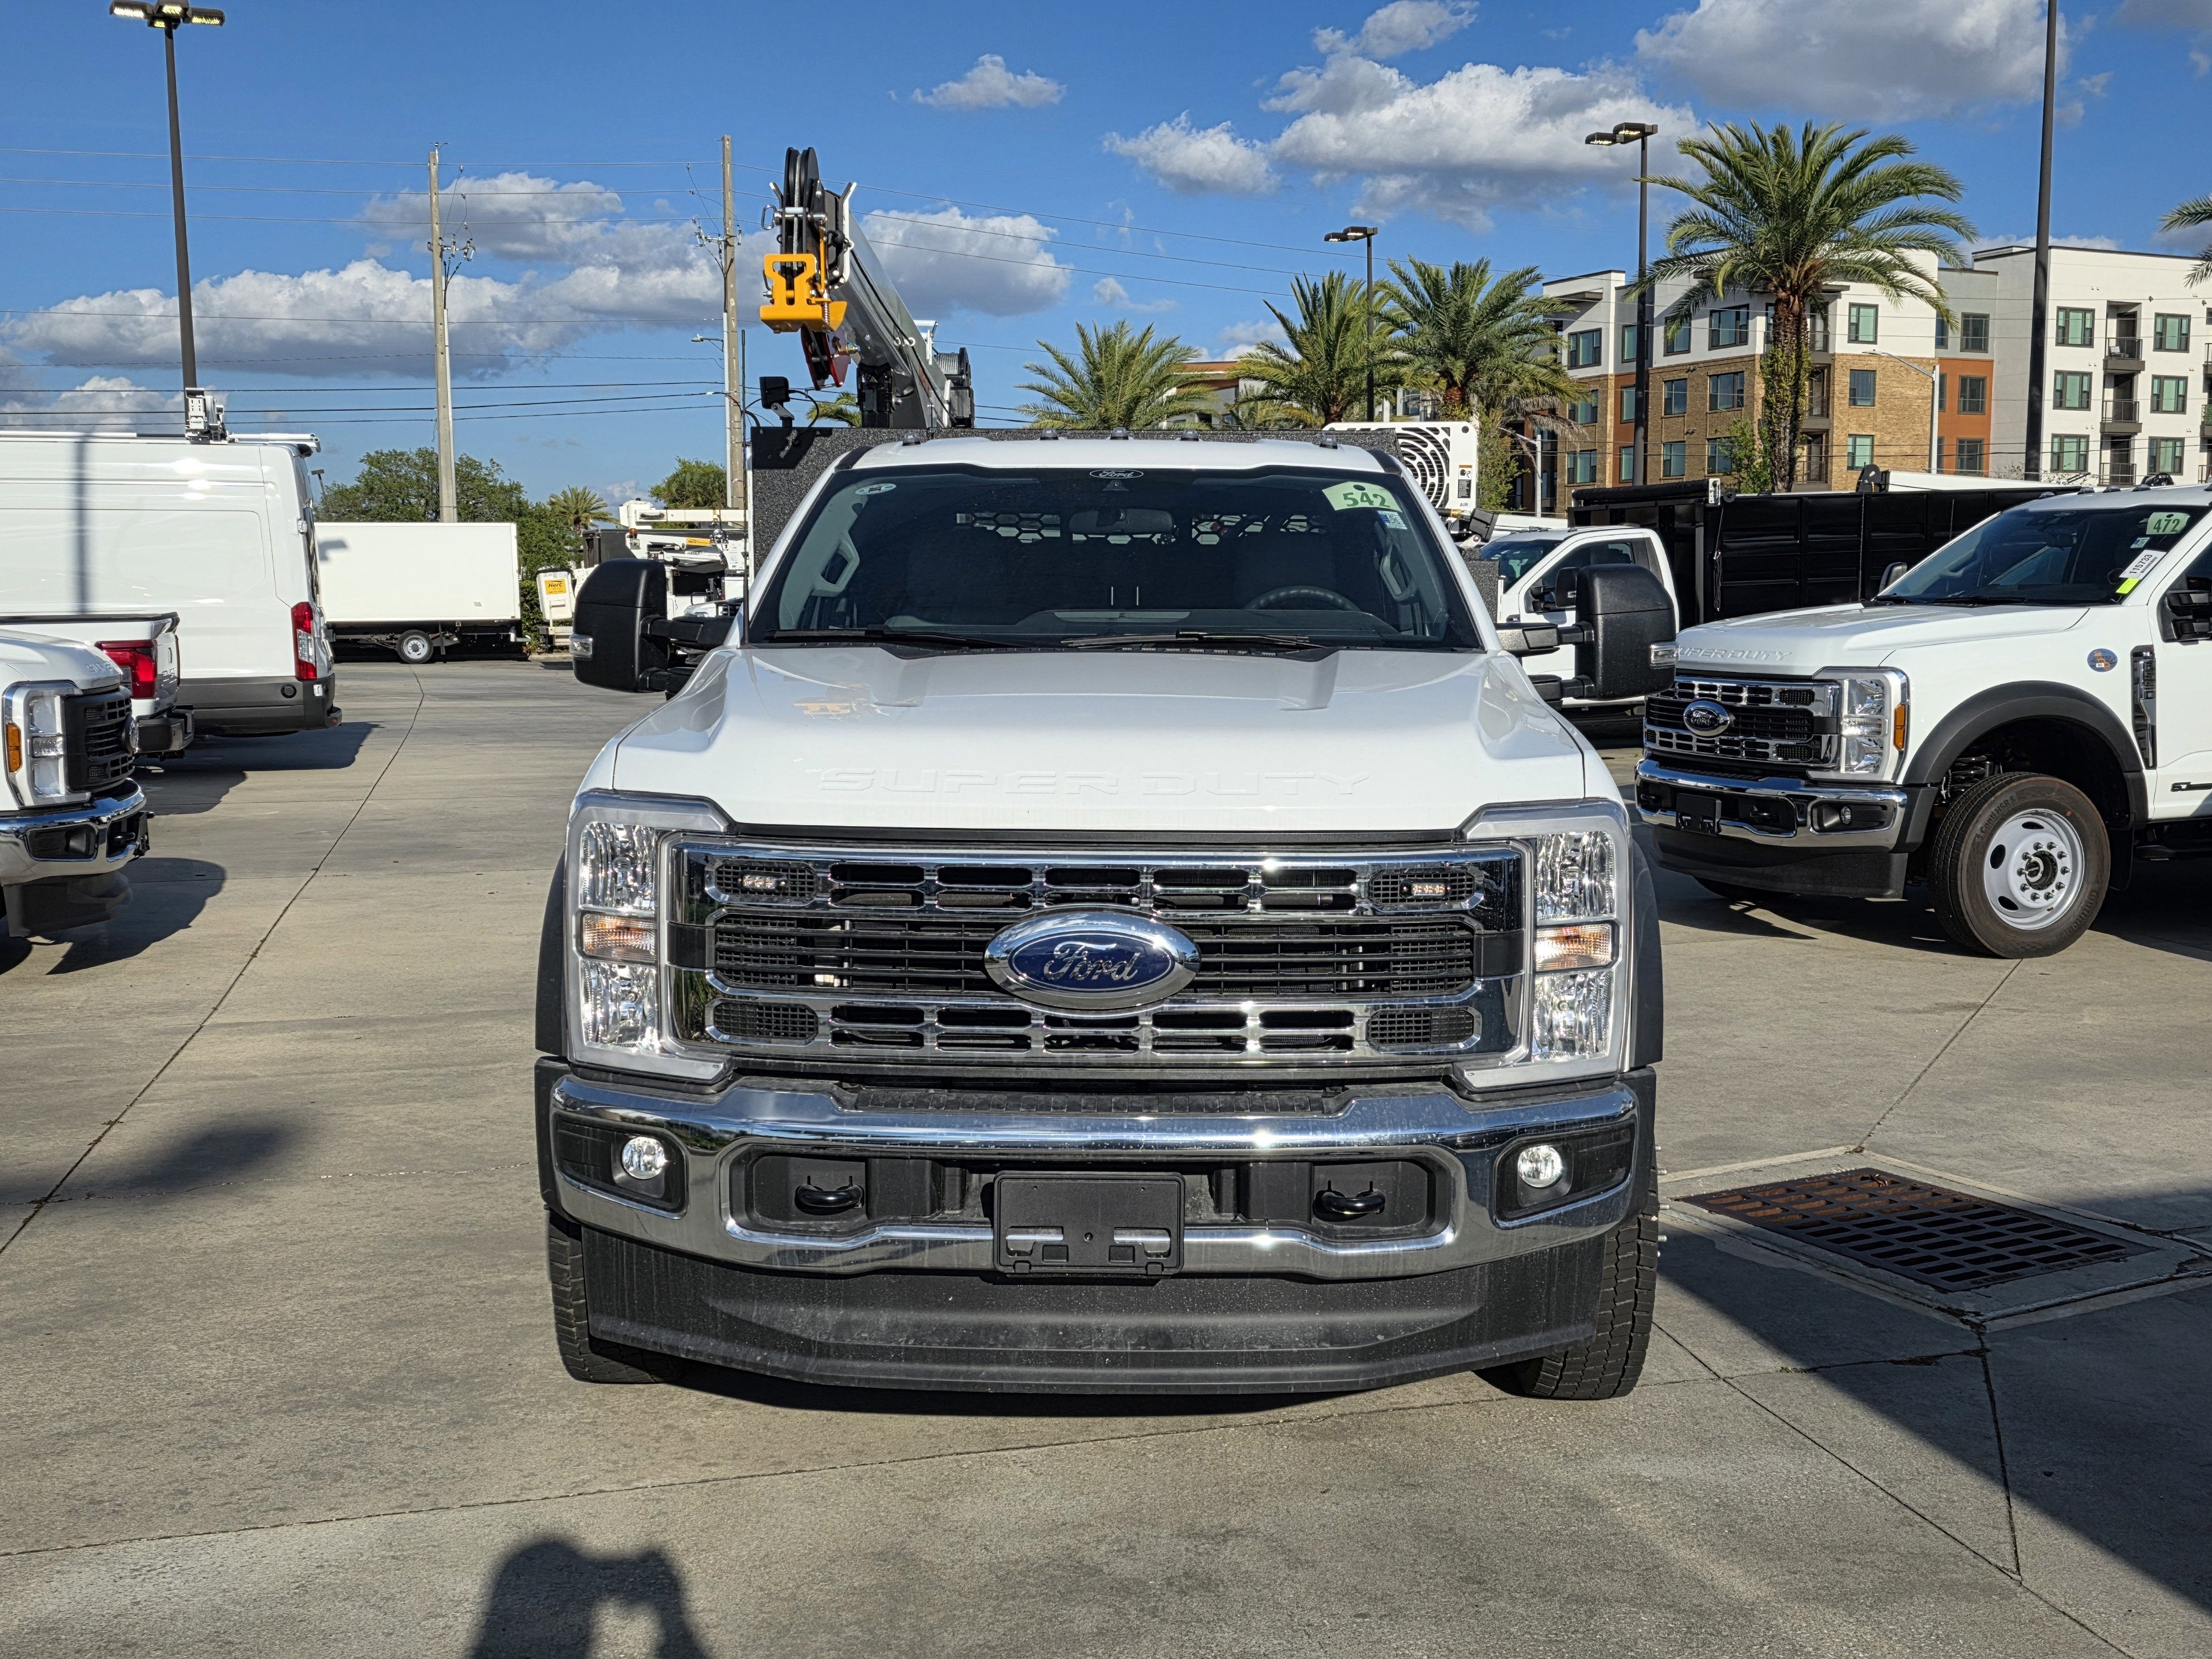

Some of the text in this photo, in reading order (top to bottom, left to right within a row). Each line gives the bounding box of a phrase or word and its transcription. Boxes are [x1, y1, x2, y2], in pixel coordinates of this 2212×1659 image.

[1343, 492, 1391, 508] 542
[2153, 519, 2180, 533] 472
[2129, 554, 2153, 574] 115733
[1679, 647, 1792, 661] UPER DUTY
[820, 769, 1371, 796] SUPER DUTY
[1043, 941, 1141, 981] Ford
